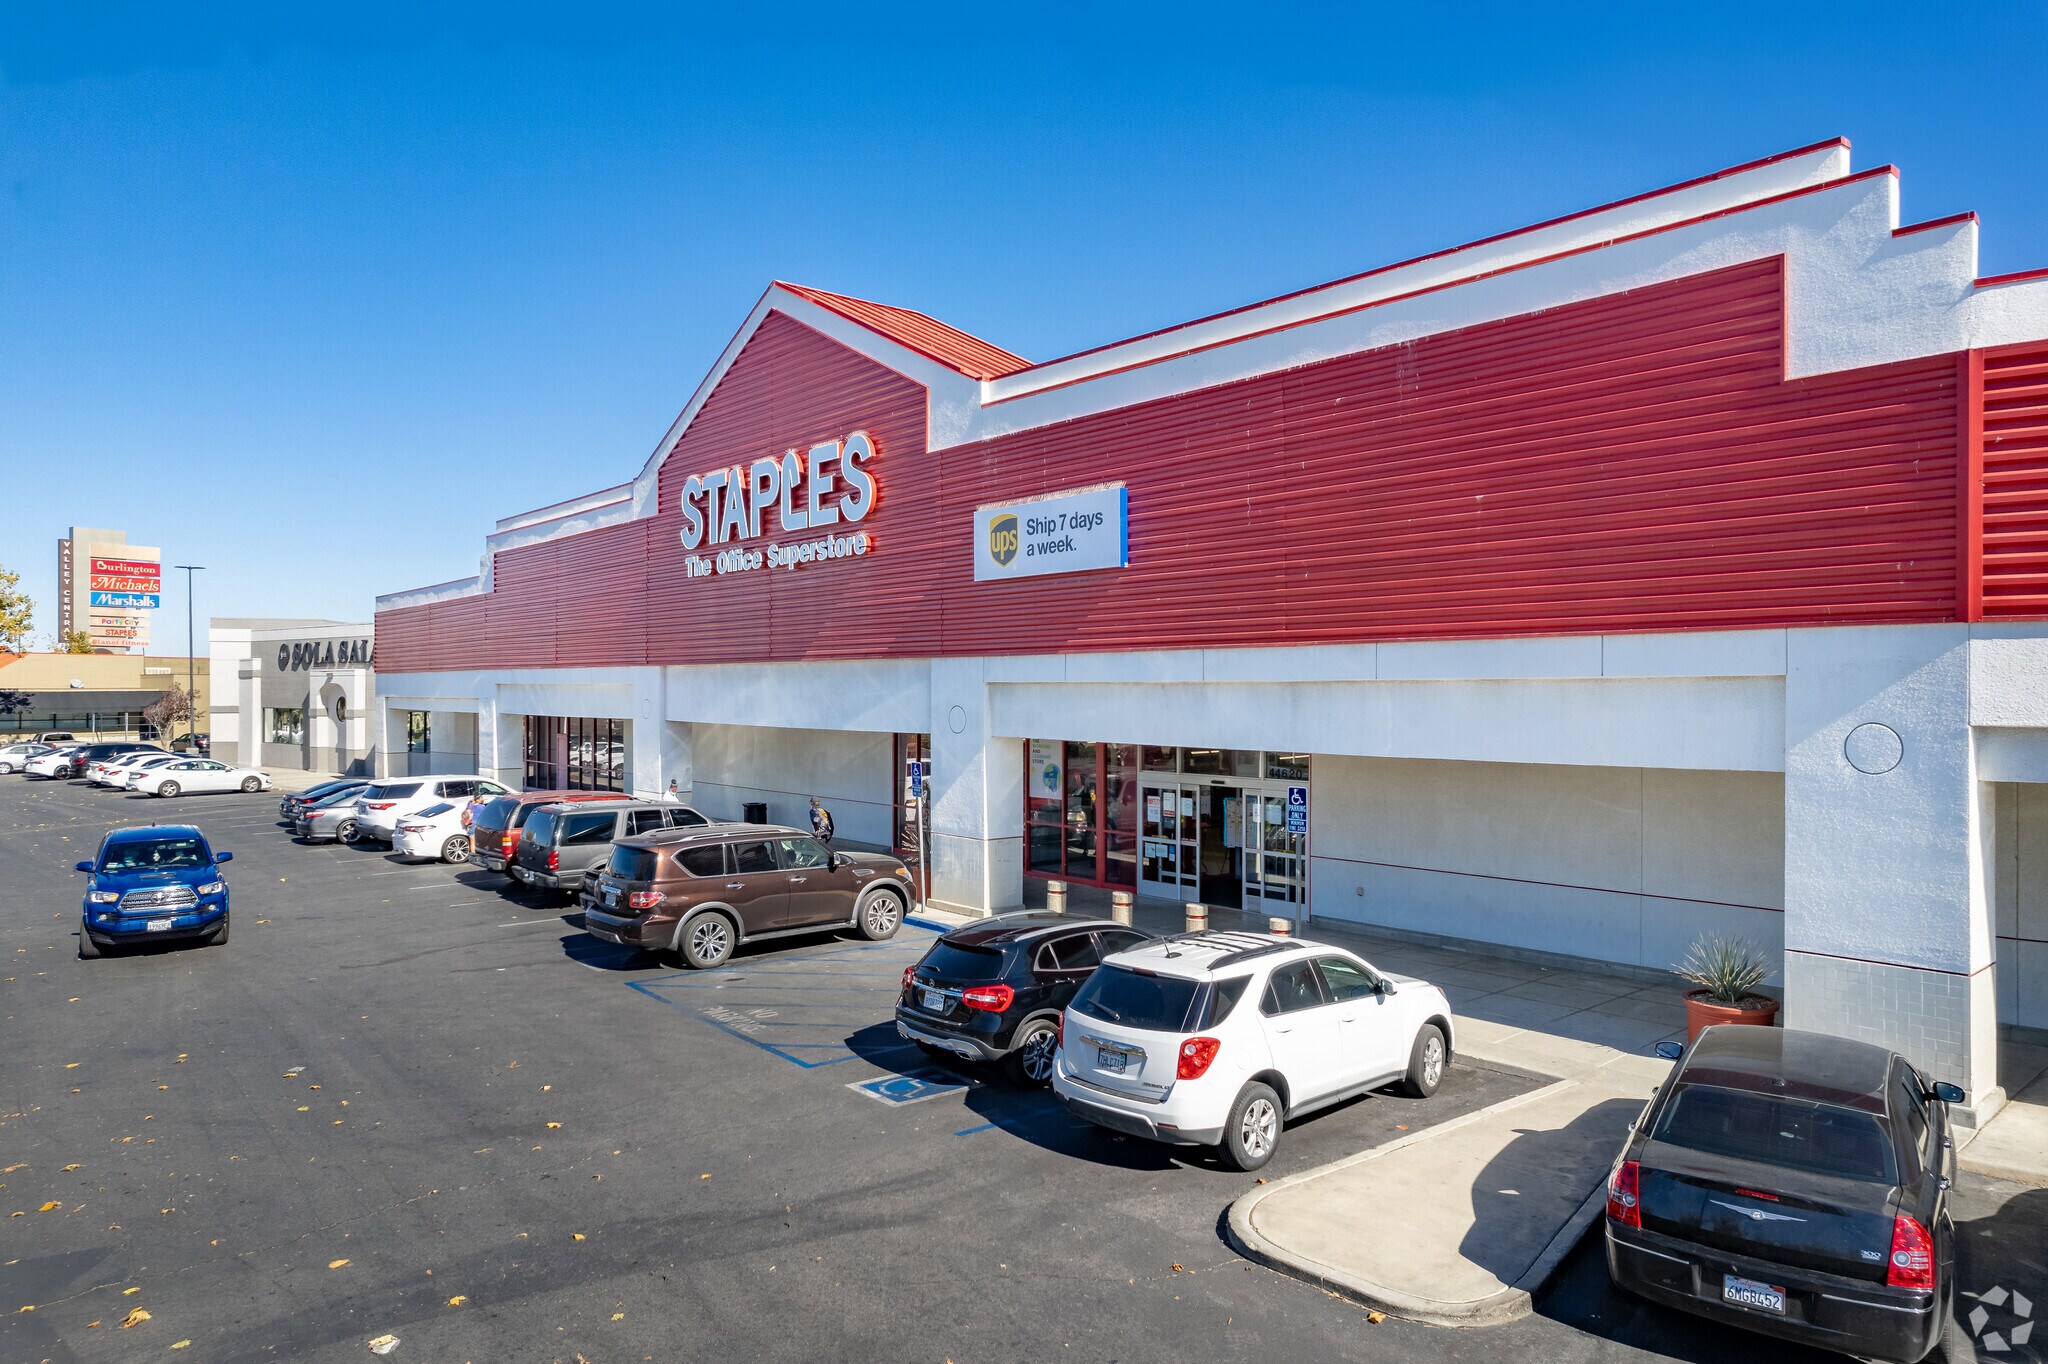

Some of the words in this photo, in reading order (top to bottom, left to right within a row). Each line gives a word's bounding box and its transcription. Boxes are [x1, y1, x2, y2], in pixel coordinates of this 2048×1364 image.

[681, 434, 877, 549] STAPLES
[1026, 516, 1056, 536] Ship
[1058, 513, 1067, 531] 7
[1069, 511, 1103, 531] days
[685, 556, 712, 578] The
[716, 550, 763, 574] Office
[767, 534, 871, 570] Superstore
[991, 530, 1017, 560] ups
[1026, 543, 1035, 556] a
[1037, 535, 1077, 555] week.
[96, 561, 156, 575] Burlington
[92, 576, 159, 591] Michaels
[96, 594, 156, 607] Marshalls
[292, 641, 336, 671] SOLA
[1269, 768, 1303, 779] 44620
[1728, 1286, 1780, 1310] 6MGB452
